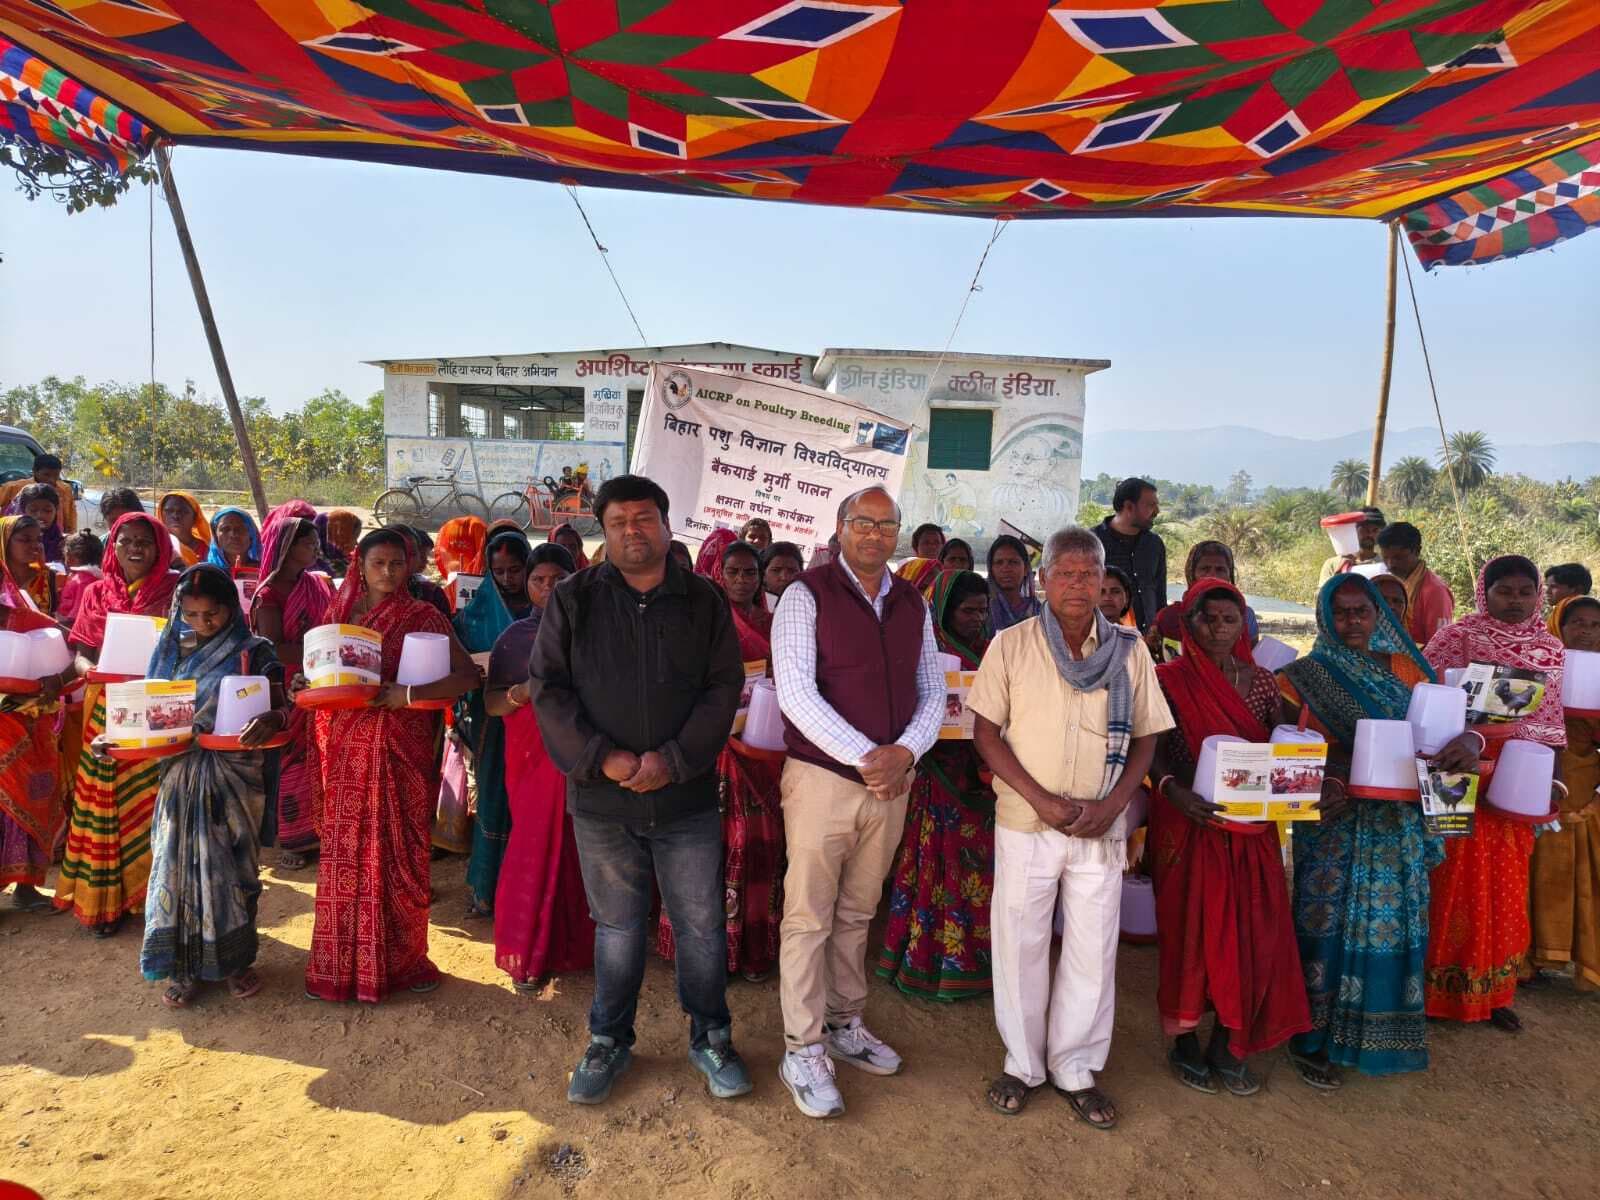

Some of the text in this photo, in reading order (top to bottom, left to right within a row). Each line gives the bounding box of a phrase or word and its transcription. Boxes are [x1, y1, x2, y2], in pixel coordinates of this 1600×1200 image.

[496, 362, 520, 377] बिहार
[521, 363, 559, 377] अभियान
[695, 388, 734, 404] AICRP
[736, 397, 751, 408] on
[754, 400, 798, 419] Poultry
[801, 410, 852, 434] Breeding
[664, 414, 702, 437] बिहार
[709, 427, 733, 451] पशु
[740, 430, 787, 456] विज्ञान
[711, 457, 832, 500] बैकयार्ड मुर्गी पालन
[716, 494, 815, 525] क्षमता वर्धन कार्यक्रम
